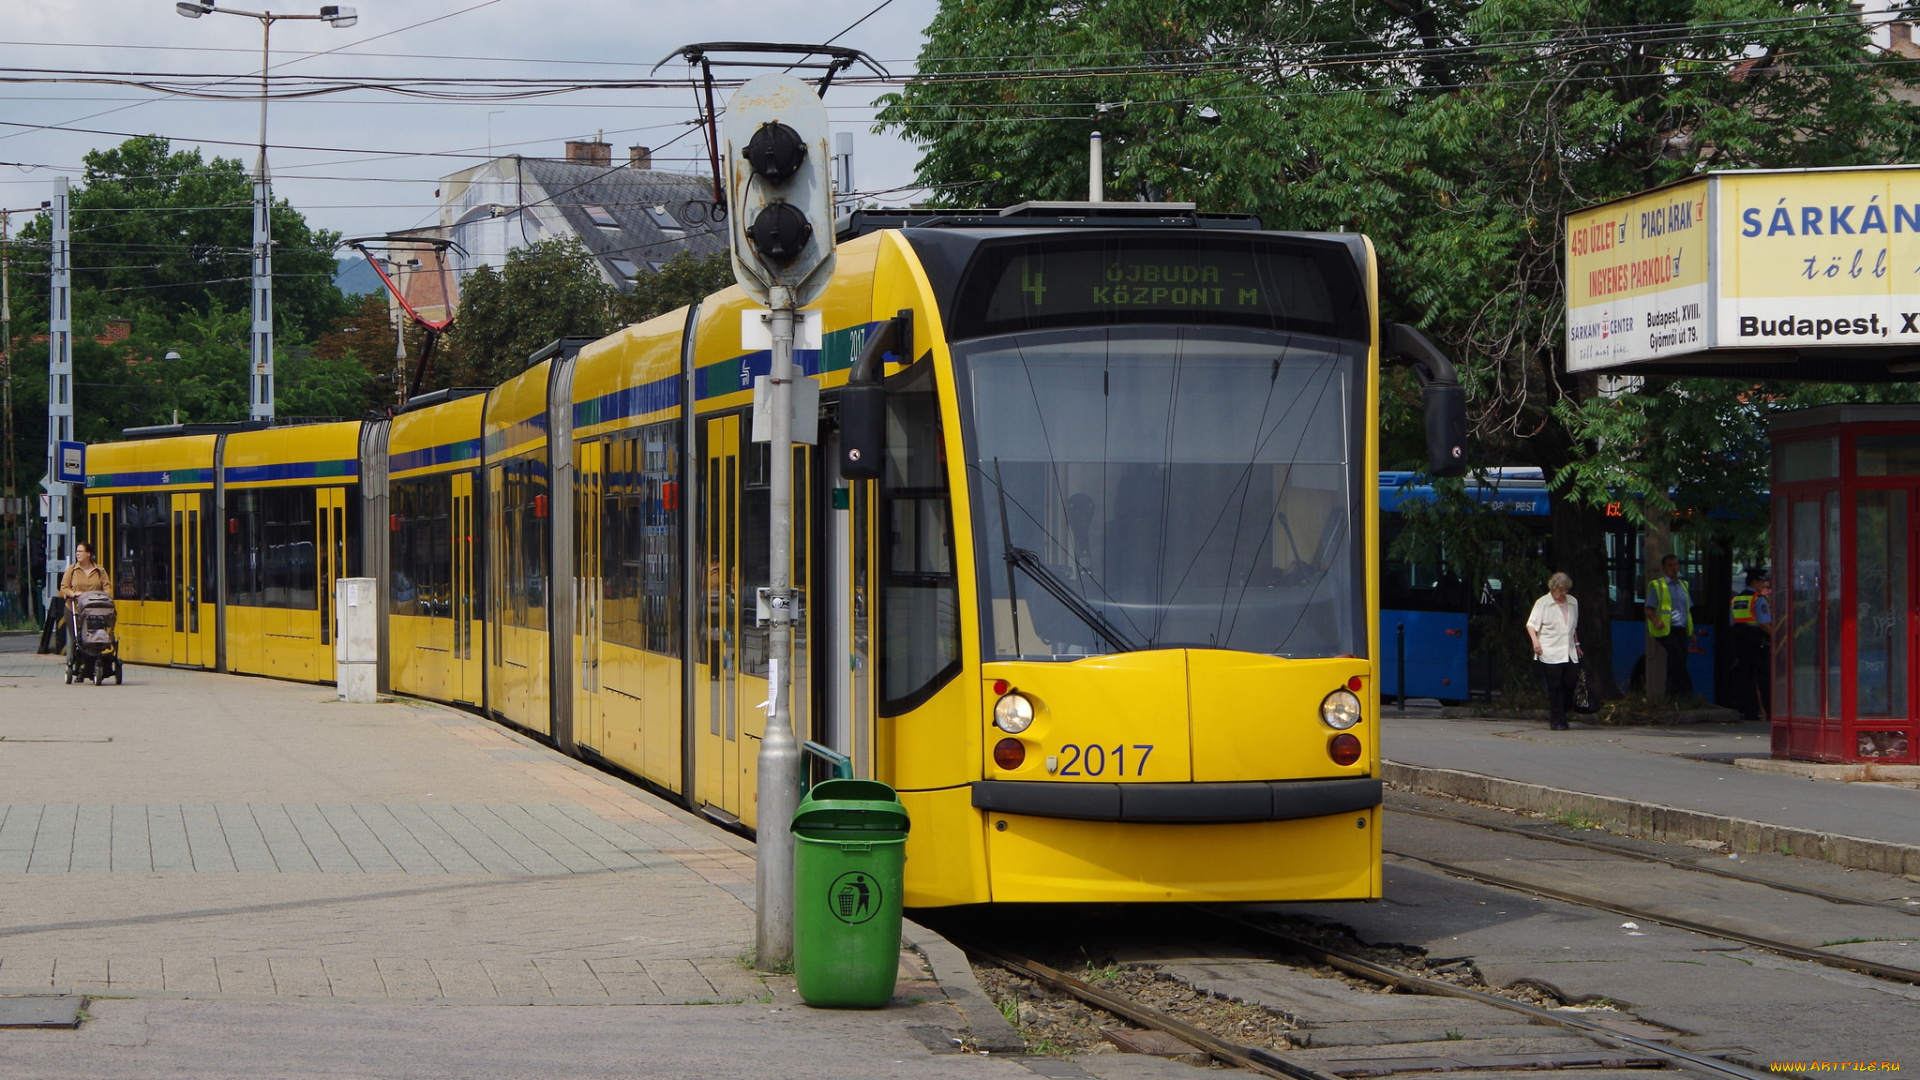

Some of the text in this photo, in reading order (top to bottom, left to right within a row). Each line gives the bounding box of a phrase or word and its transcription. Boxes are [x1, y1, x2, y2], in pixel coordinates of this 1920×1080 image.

[1641, 198, 1692, 239] PIACI ÁRAK
[1742, 195, 1920, 238] SÁRKÁN
[1571, 219, 1616, 257] 450 ÜZLET
[1106, 263, 1219, 283] ÚJBUDA
[1589, 247, 1671, 298] INGYENES PARKOLÓ
[1801, 248, 1887, 280] több
[1021, 263, 1047, 305] 4
[1092, 285, 1258, 305] KÖZPONT M
[1571, 317, 1634, 341] SÁRKÁNY CENTER
[1647, 303, 1701, 329] Budapest, XVIII.
[1740, 313, 1920, 340] Budapest, X
[1679, 327, 1686, 344] út
[1688, 325, 1699, 343] 79.
[1059, 743, 1154, 776] 2017
